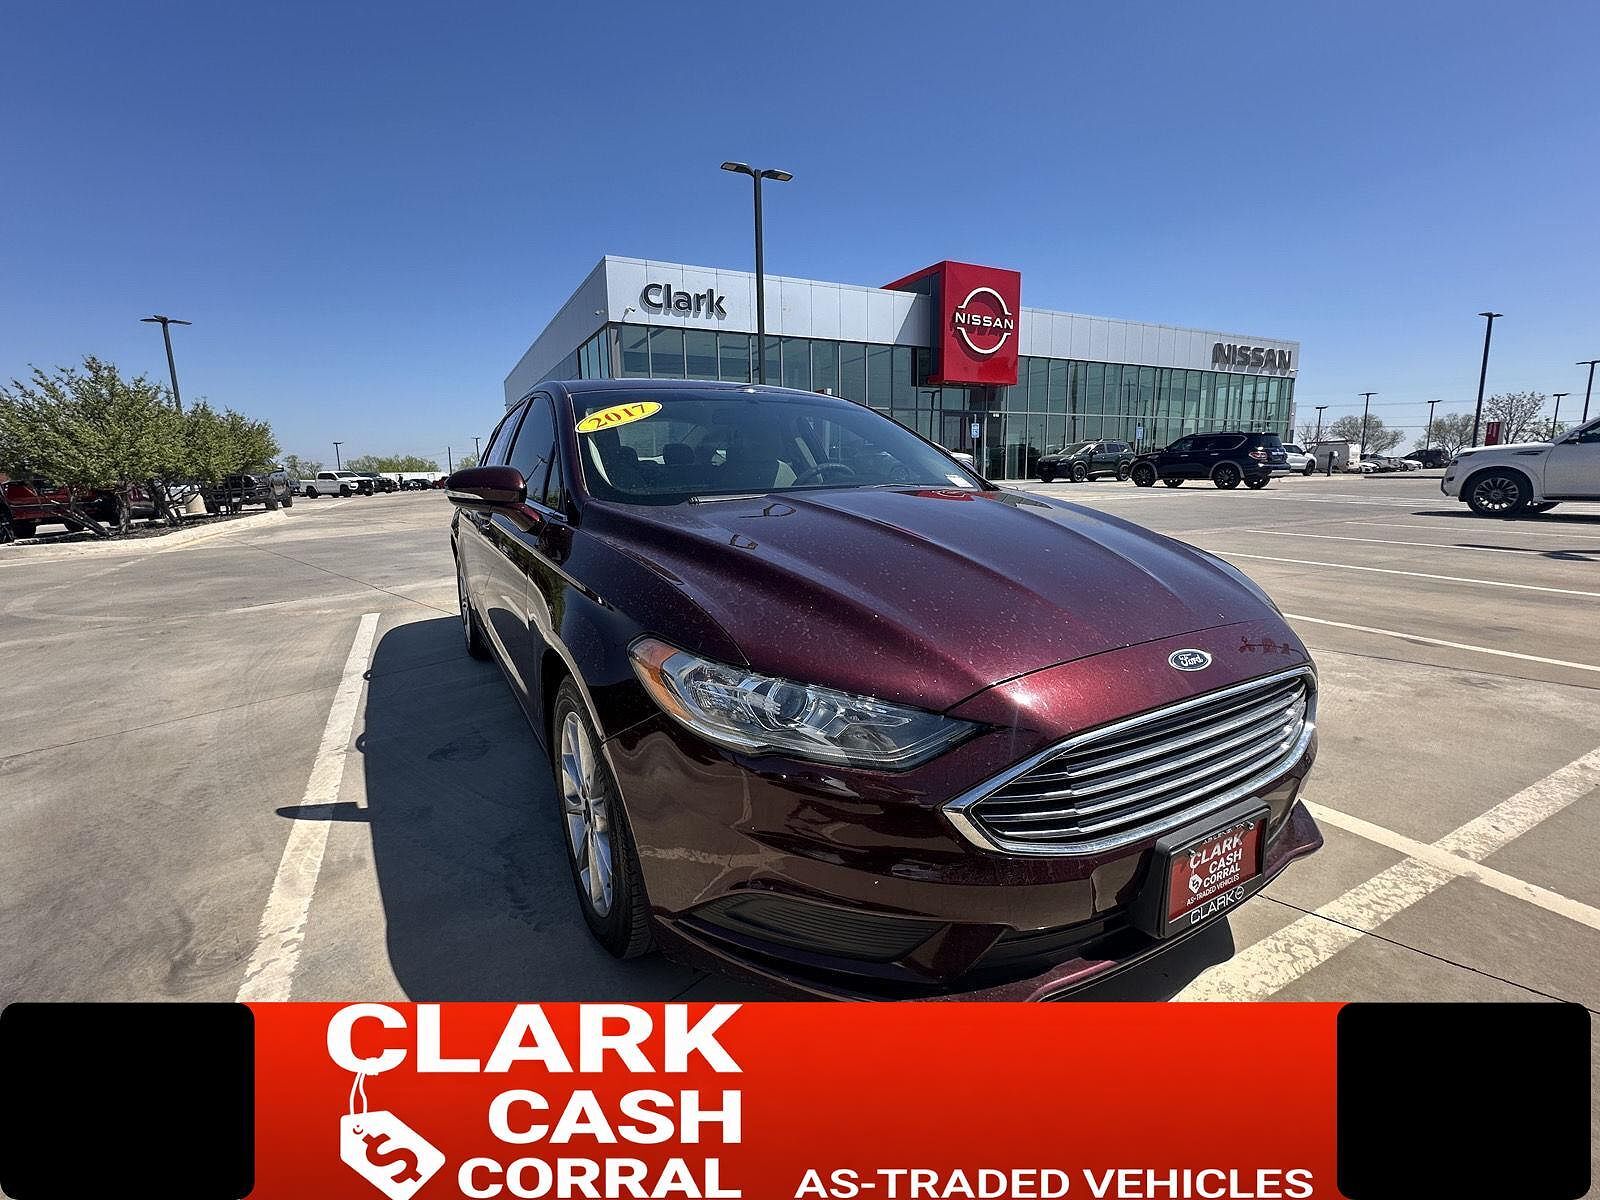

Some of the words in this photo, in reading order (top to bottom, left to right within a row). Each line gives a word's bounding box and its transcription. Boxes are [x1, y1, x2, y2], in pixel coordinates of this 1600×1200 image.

[640, 283, 727, 318] Clark
[955, 312, 1014, 330] NISSAN
[1211, 342, 1292, 371] NISSAN
[588, 403, 645, 429] 2017
[1179, 653, 1204, 667] Ford
[1189, 832, 1243, 869] CLARK
[1209, 848, 1242, 874] CASH
[1203, 862, 1241, 888] CORRAL
[1186, 885, 1217, 906] AS-TRADED
[1216, 873, 1240, 890] VEHICLES
[1190, 889, 1235, 925] CLARK
